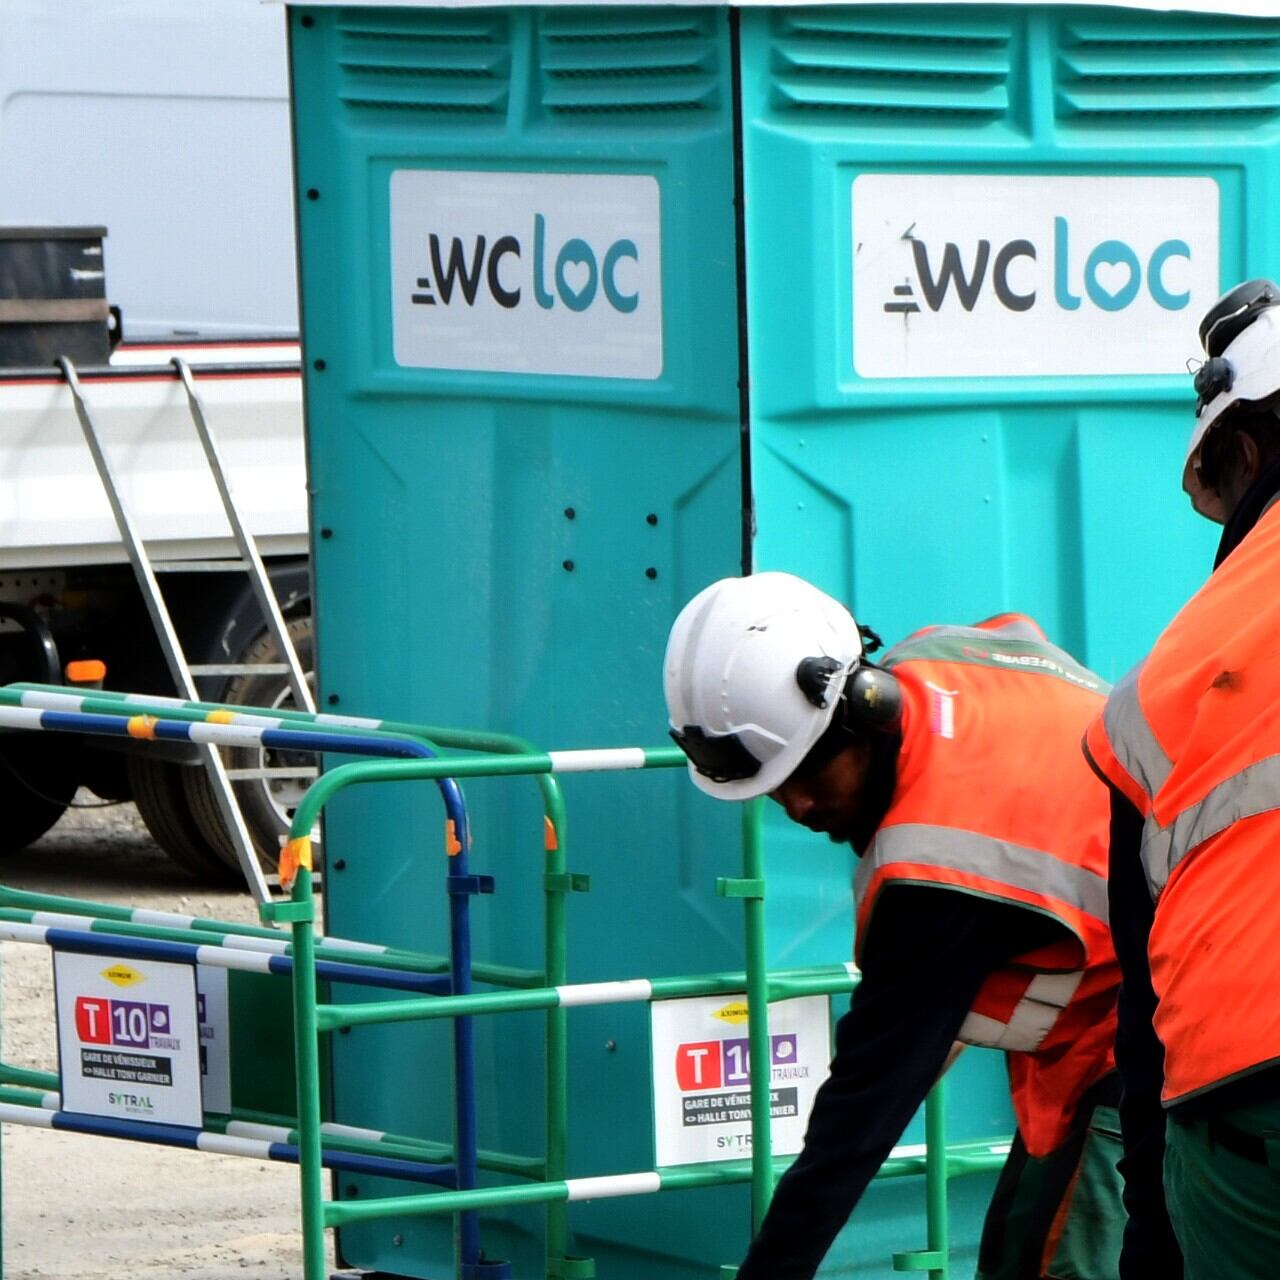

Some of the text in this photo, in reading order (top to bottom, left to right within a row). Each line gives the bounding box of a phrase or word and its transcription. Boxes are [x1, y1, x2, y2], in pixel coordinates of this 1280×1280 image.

[83, 1003, 147, 1043] T 10
[686, 1045, 751, 1084] T 1
[772, 1066, 809, 1081] TRAVAUX
[108, 1092, 154, 1109] SYTRAL
[684, 1098, 710, 1111] GARE
[710, 1096, 724, 1108] DE
[697, 1110, 728, 1123] HALLE
